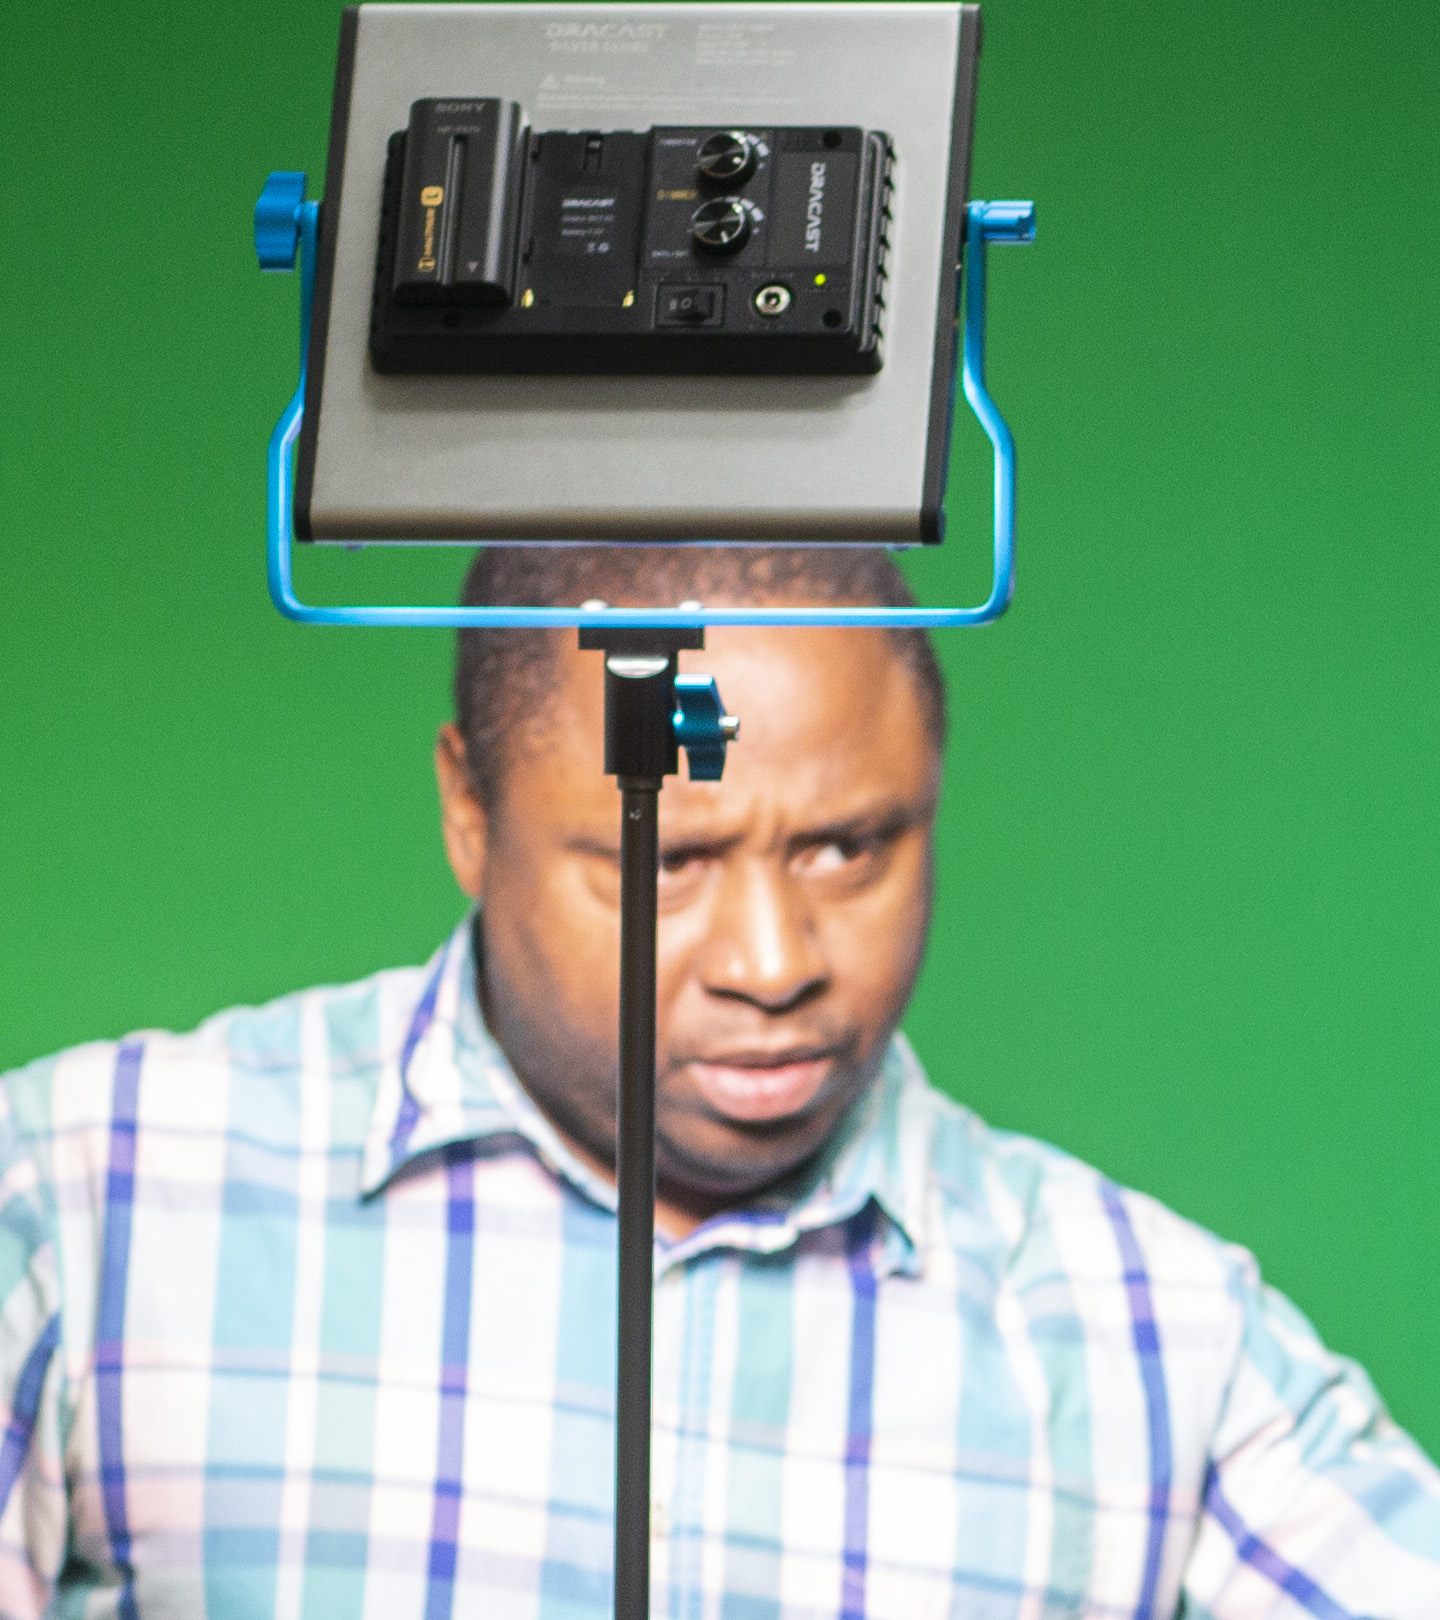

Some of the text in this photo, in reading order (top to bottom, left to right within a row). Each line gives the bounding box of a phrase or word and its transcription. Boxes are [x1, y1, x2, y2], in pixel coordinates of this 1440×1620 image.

[545, 22, 669, 39] DRACAST
[435, 102, 486, 113] SONY
[804, 162, 827, 253] DRACAST
